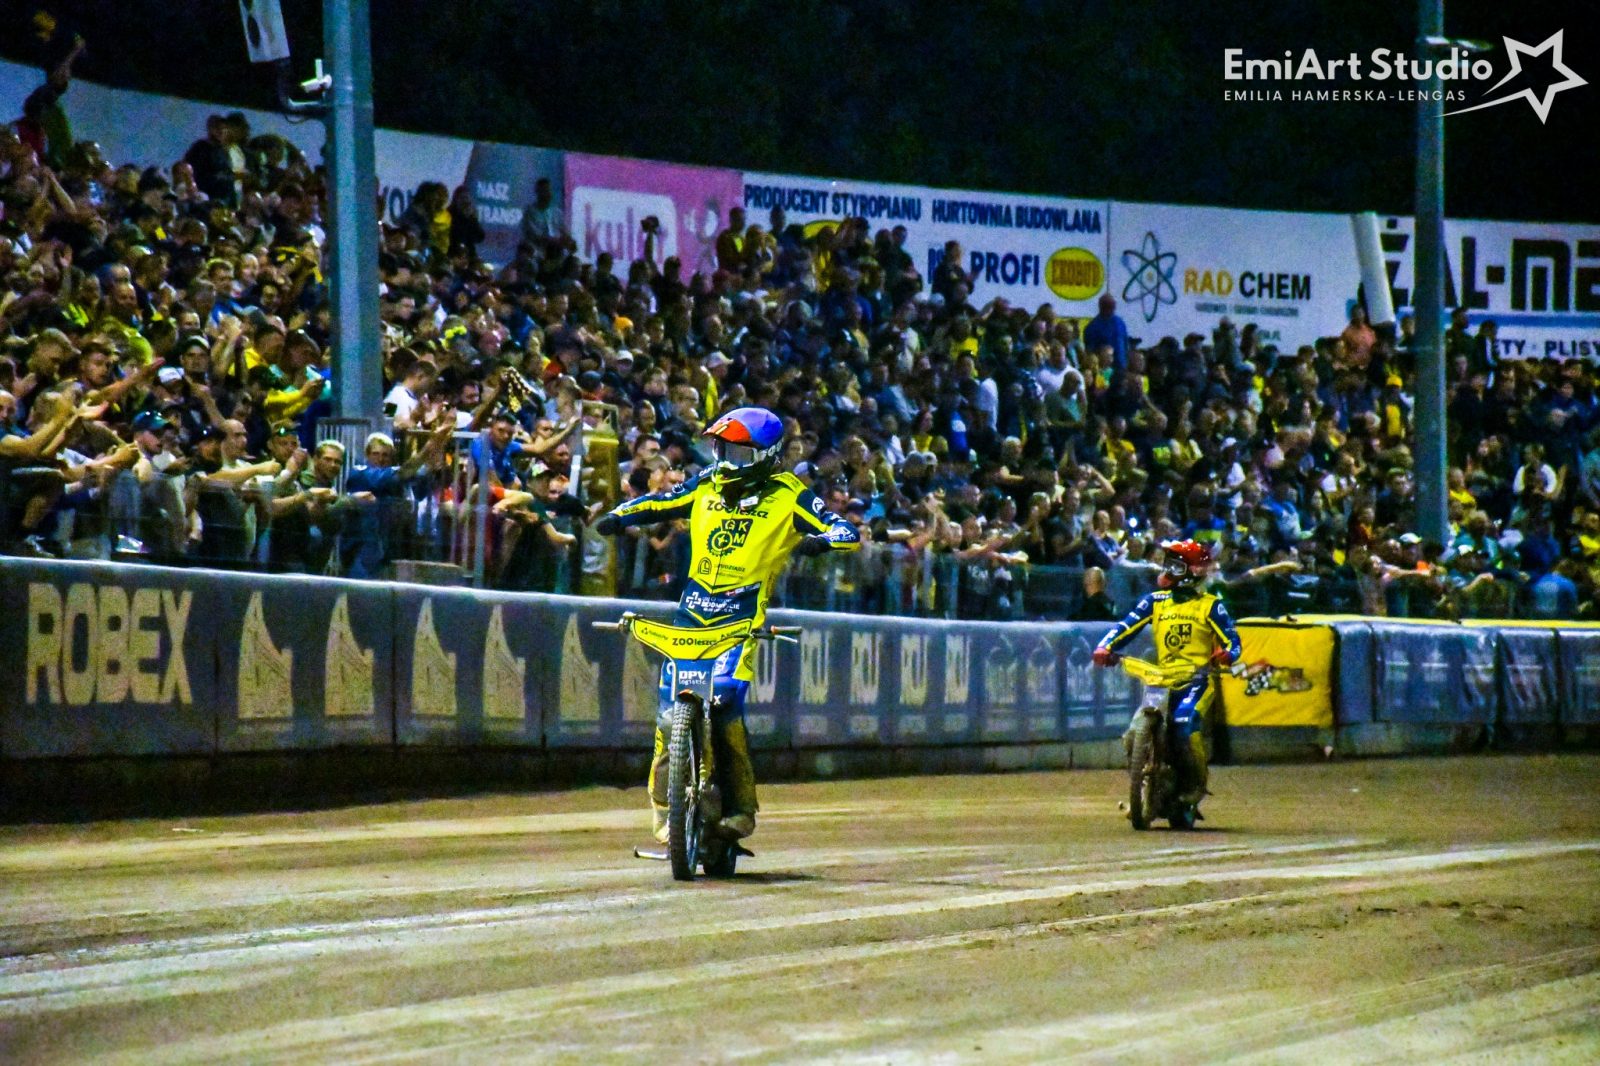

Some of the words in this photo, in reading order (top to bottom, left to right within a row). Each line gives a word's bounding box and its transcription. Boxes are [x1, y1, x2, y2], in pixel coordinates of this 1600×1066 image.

[744, 184, 829, 214] PRODUCENT
[832, 192, 922, 221] STYROPIANU
[932, 199, 1013, 228] HURTOWNIA
[1015, 205, 1102, 234] BUDOWLANA
[1239, 271, 1312, 300] CHEM
[679, 670, 707, 680] DPV
